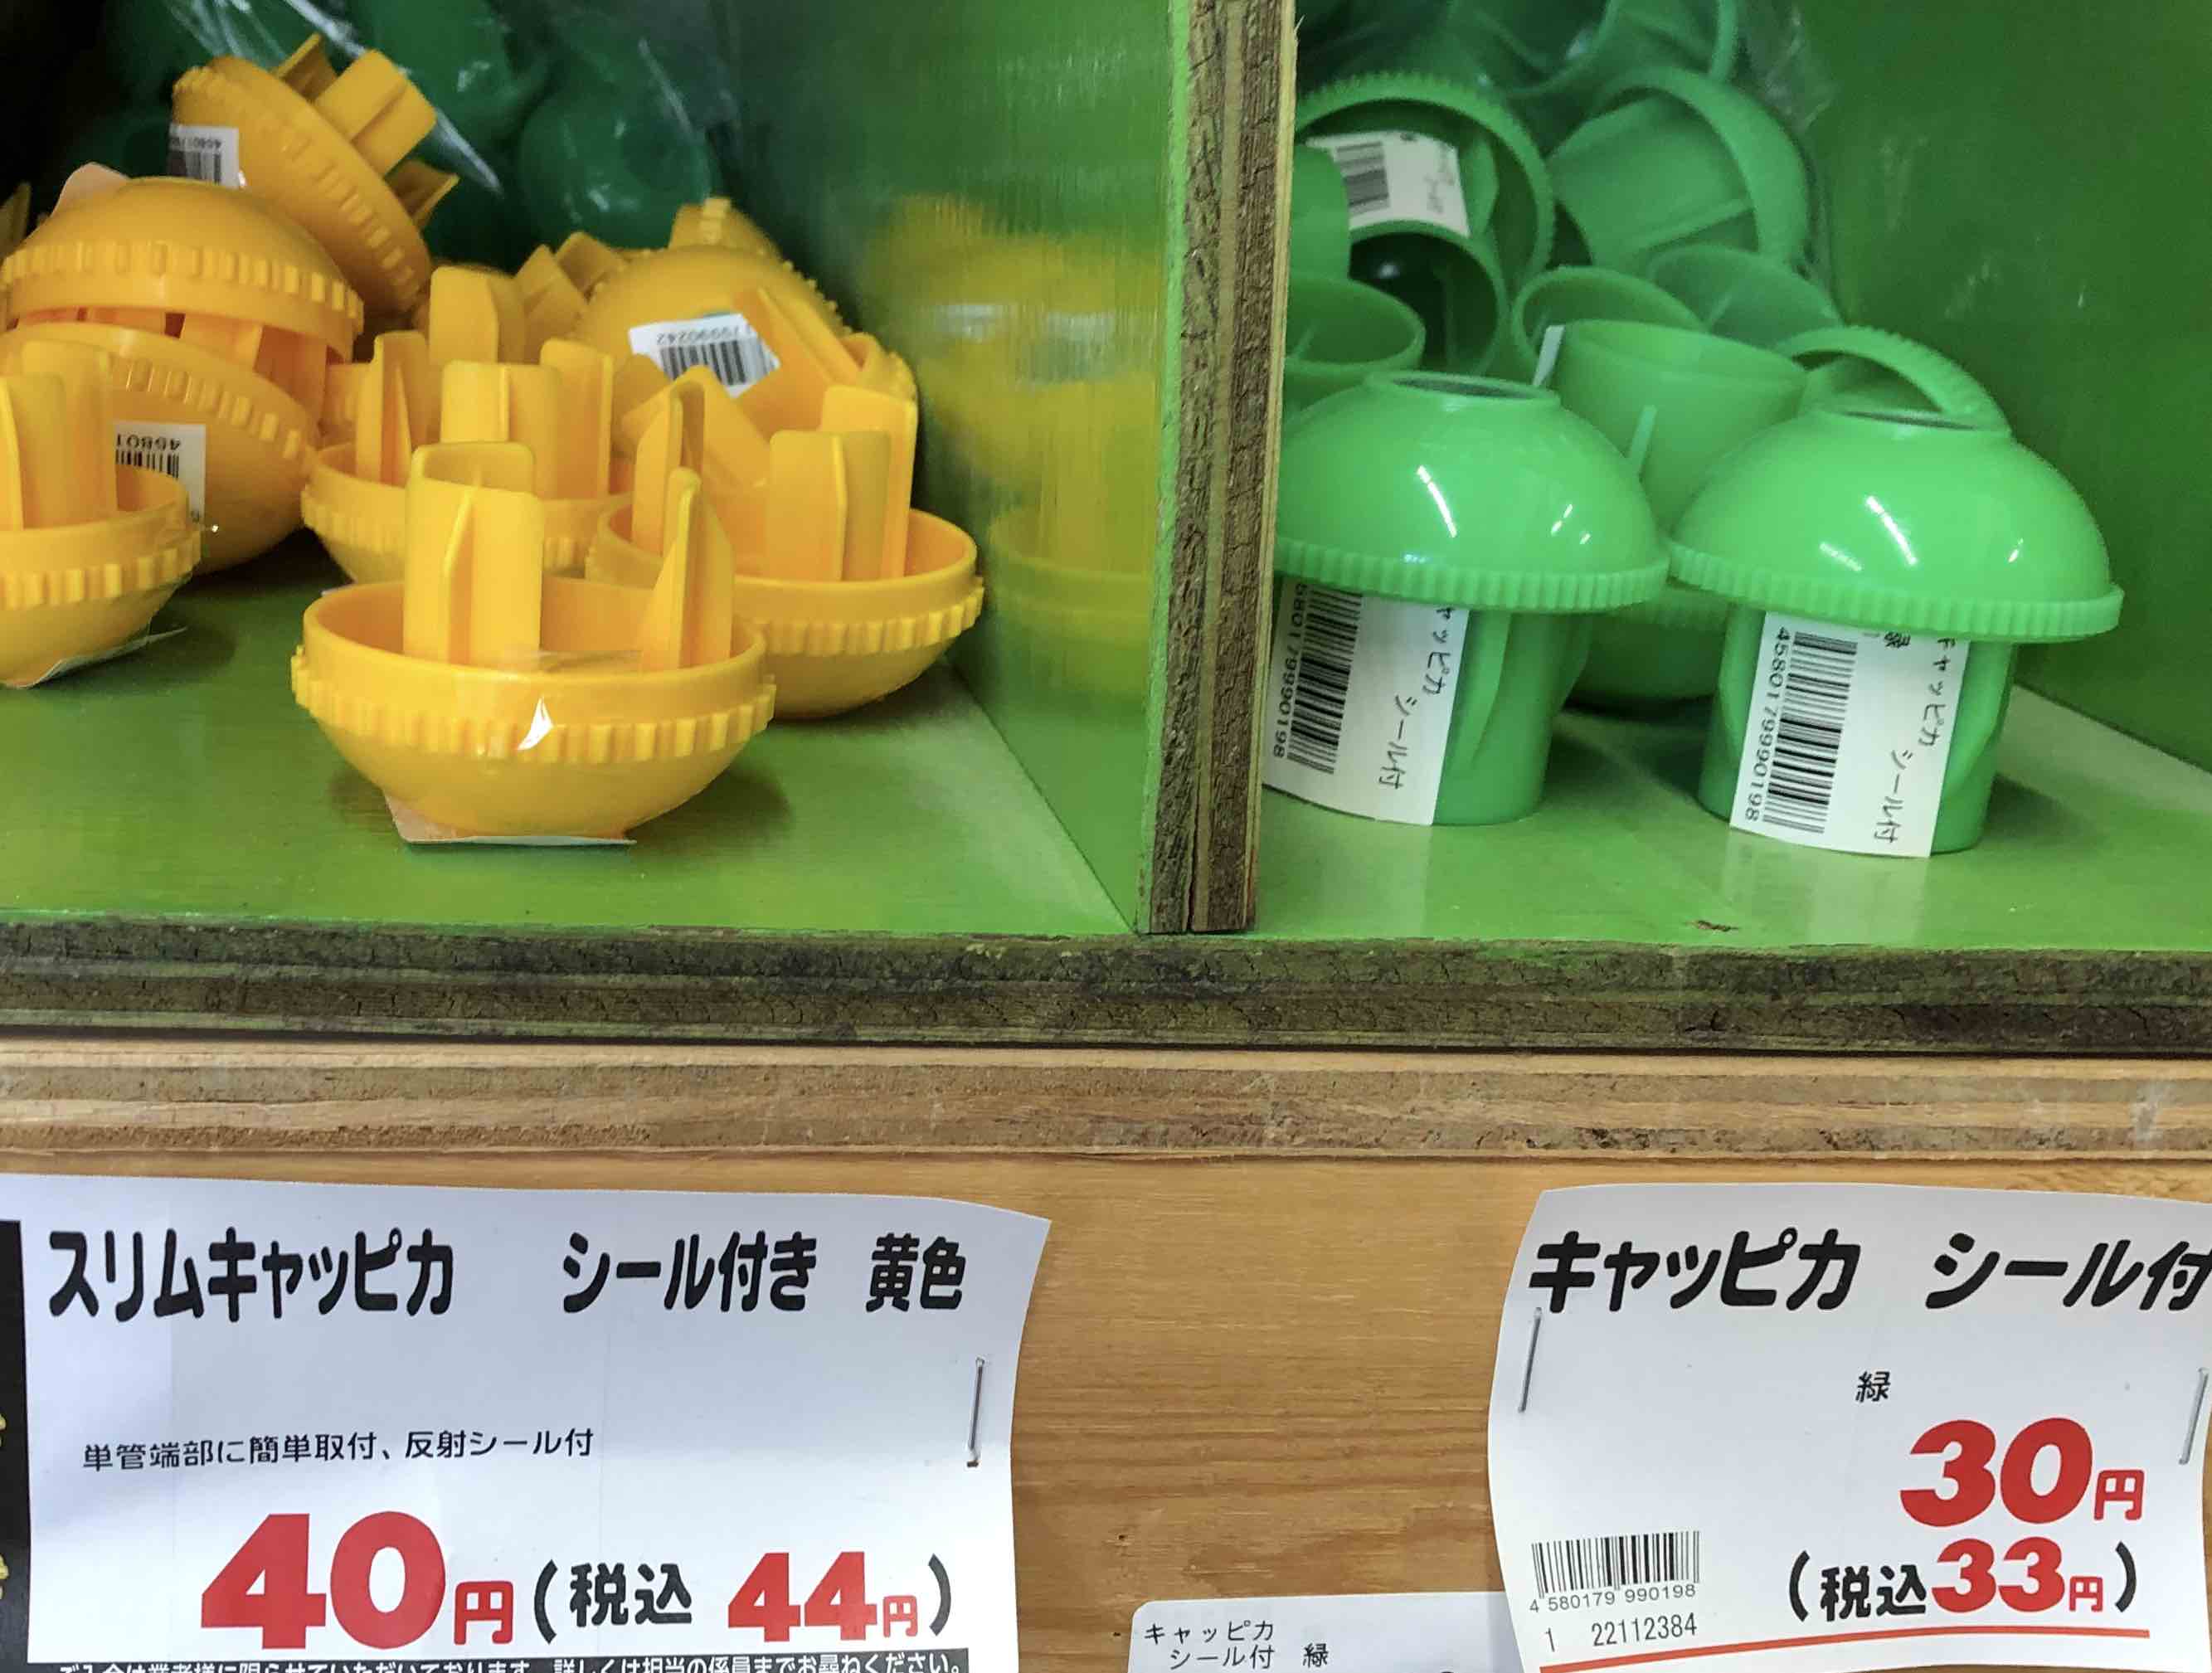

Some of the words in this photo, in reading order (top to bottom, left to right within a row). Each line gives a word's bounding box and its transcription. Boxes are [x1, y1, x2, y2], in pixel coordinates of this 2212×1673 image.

[1378, 694, 1417, 790] シール付
[1745, 626, 1791, 821] 4580179990198
[1874, 750, 1913, 843] シール付
[50, 1227, 453, 1322] スリムキャッピカ
[563, 1230, 816, 1313] シール付き
[866, 1233, 965, 1312] 黄色
[1529, 1227, 1860, 1313] キャッピカ
[1925, 1232, 2212, 1311] シール付
[1856, 1371, 1891, 1403] 緑
[83, 1427, 594, 1472] 単管端部に簡単取付、反射シール付
[1900, 1418, 2145, 1527] 30円
[201, 1511, 514, 1650] 40円
[1548, 1590, 1616, 1612] 580179
[1624, 1583, 1696, 1603] 990198
[1144, 1621, 1274, 1645] キャッピカ
[1170, 1644, 1276, 1670] シール付
[1302, 1642, 1329, 1668] 緑
[1591, 1612, 1698, 1647] 22112384
